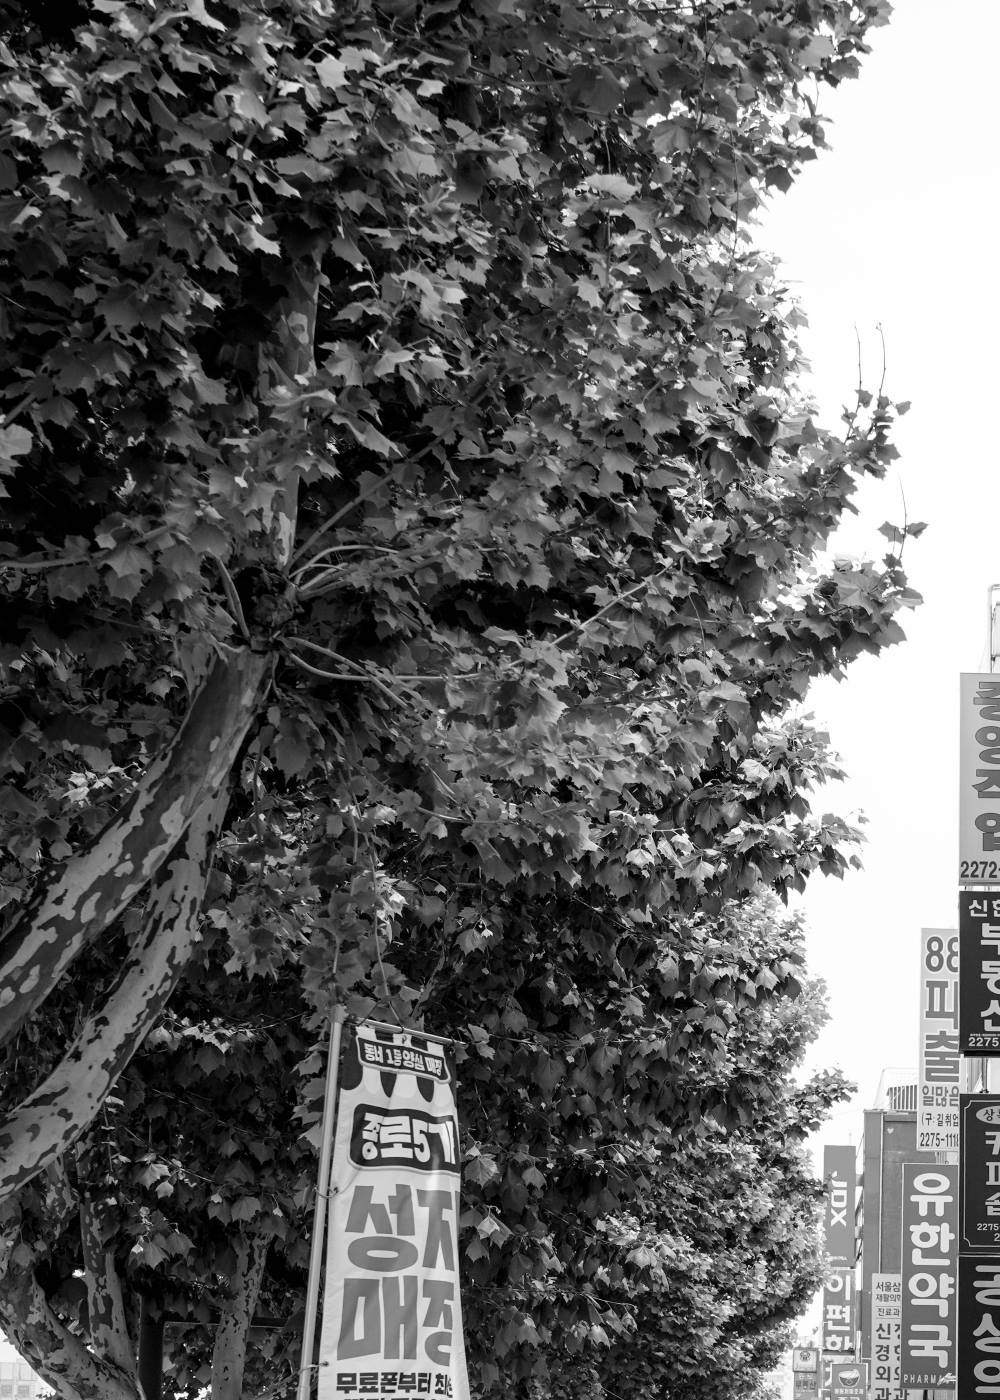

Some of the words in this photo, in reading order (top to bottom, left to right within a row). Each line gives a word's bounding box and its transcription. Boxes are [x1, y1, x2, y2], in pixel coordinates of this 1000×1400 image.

[907, 1173, 956, 1369] 유한약국
[336, 1371, 432, 1395] 무료폰부터
[903, 1373, 957, 1385] PHARM
